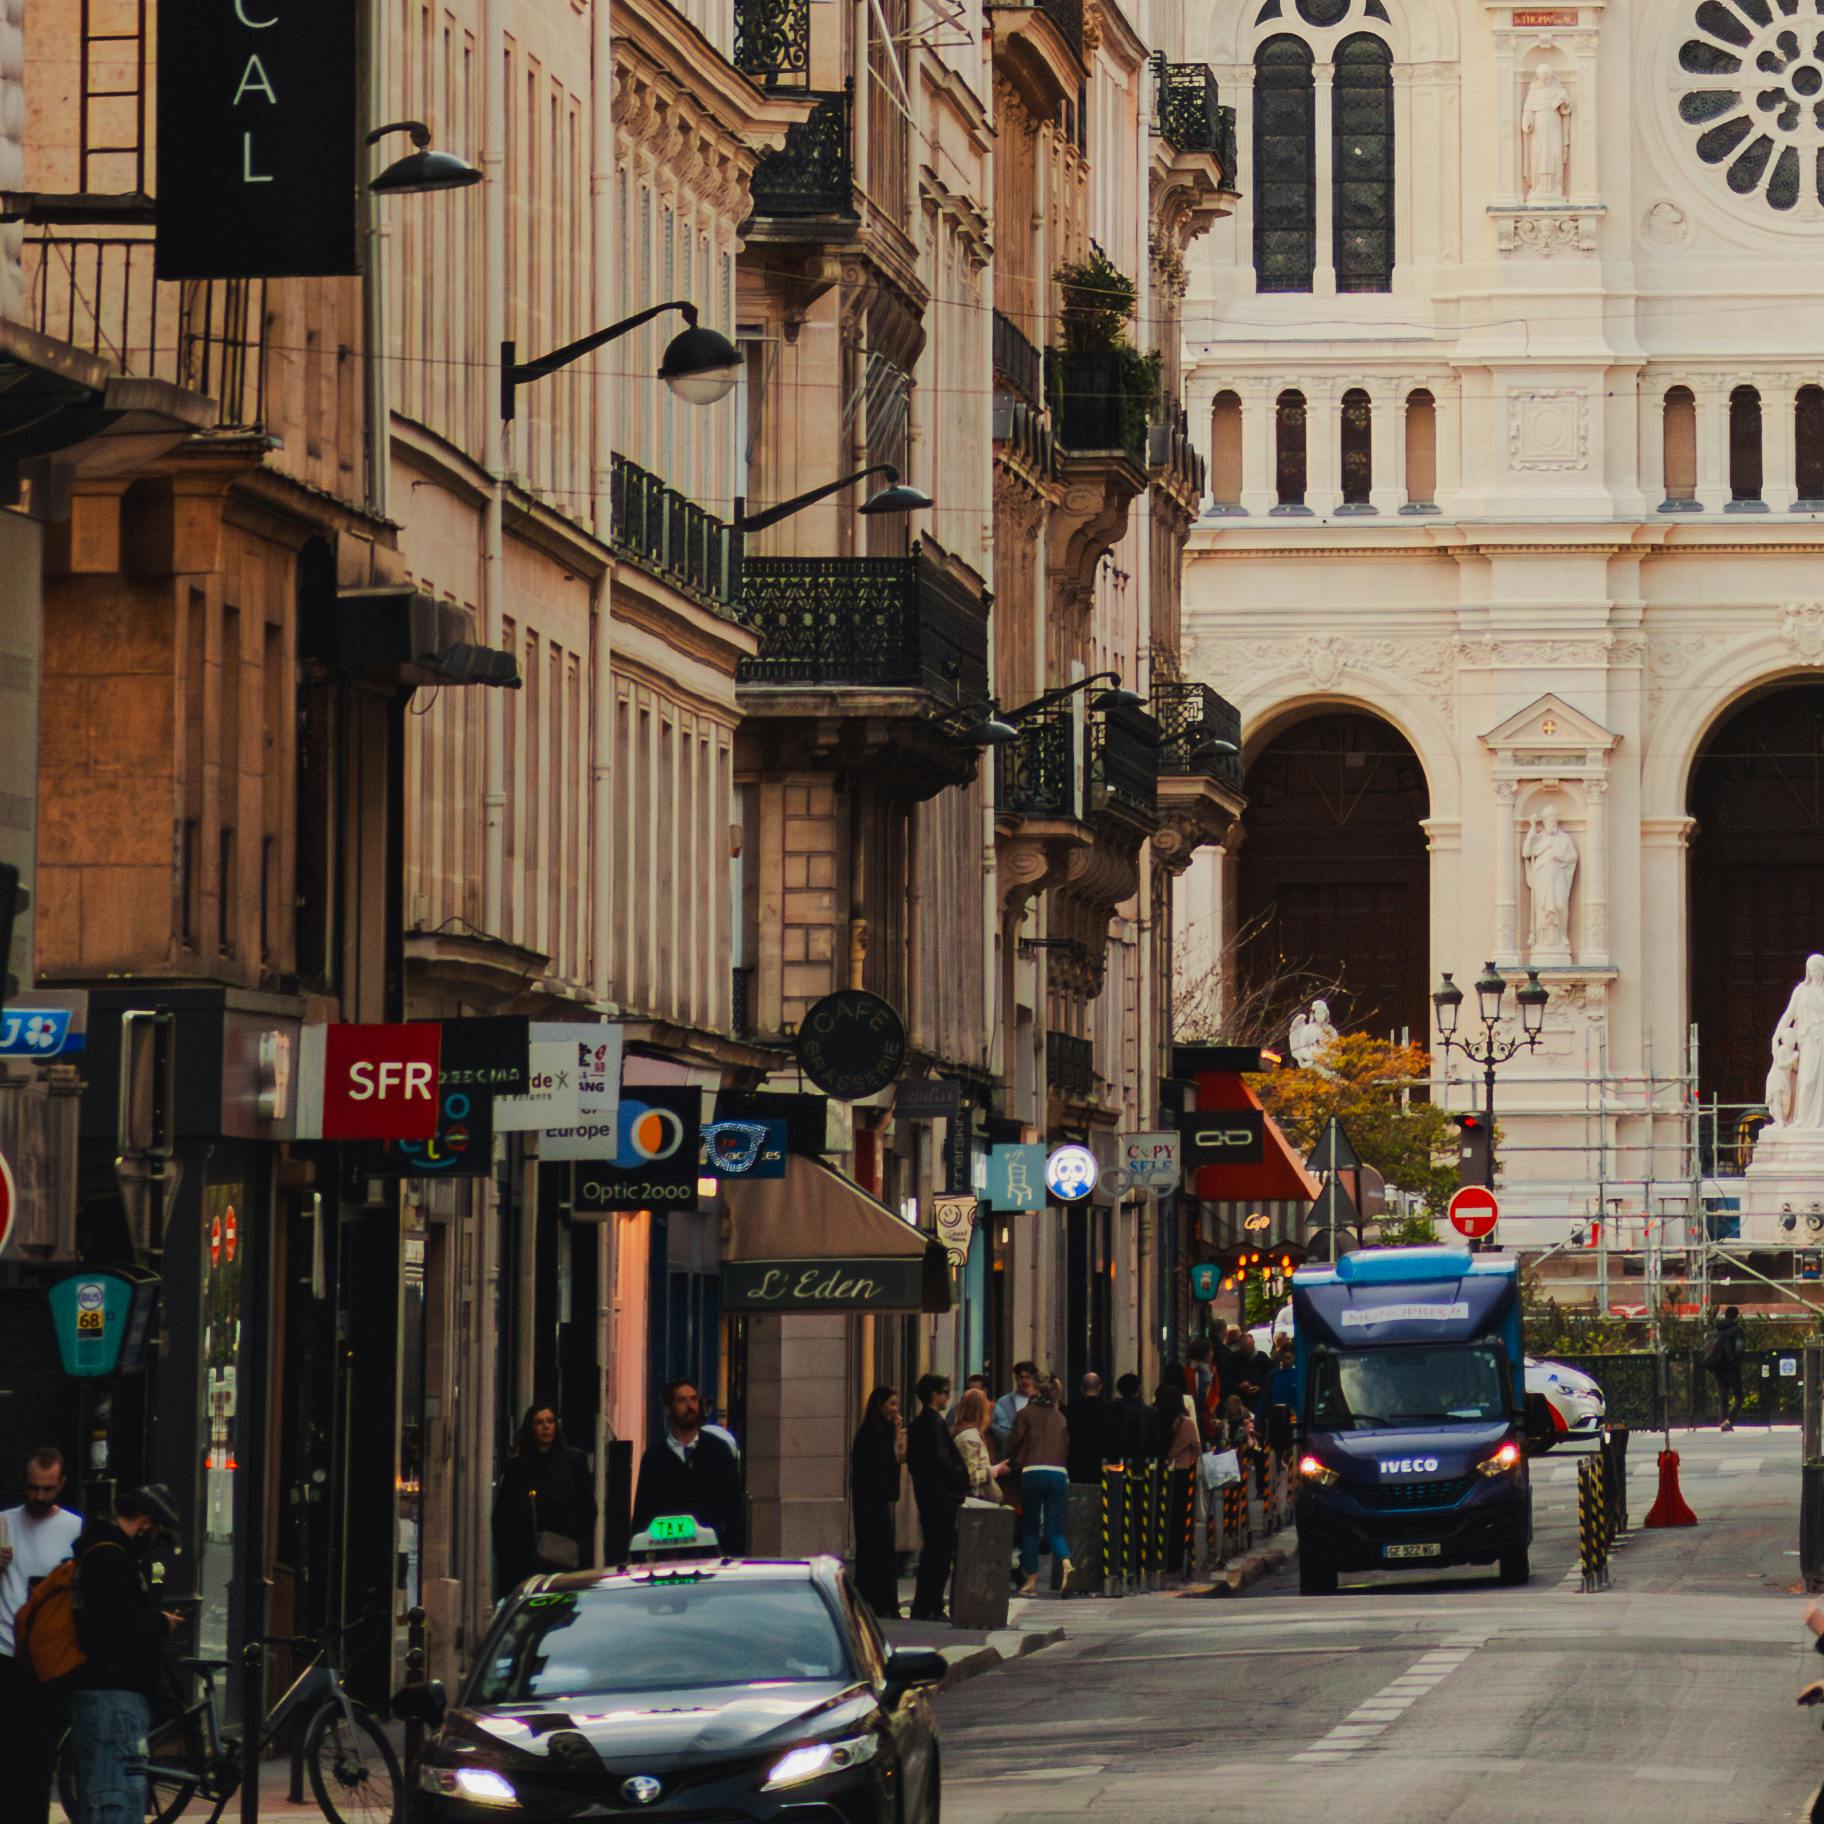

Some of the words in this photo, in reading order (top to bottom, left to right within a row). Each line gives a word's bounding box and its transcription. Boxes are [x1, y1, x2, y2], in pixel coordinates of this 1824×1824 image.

[348, 1060, 433, 1101] SFR
[583, 1181, 639, 1204] Optic
[642, 1181, 692, 1201] 2000
[79, 1313, 100, 1328] 68
[1380, 1458, 1438, 1473] IVECO
